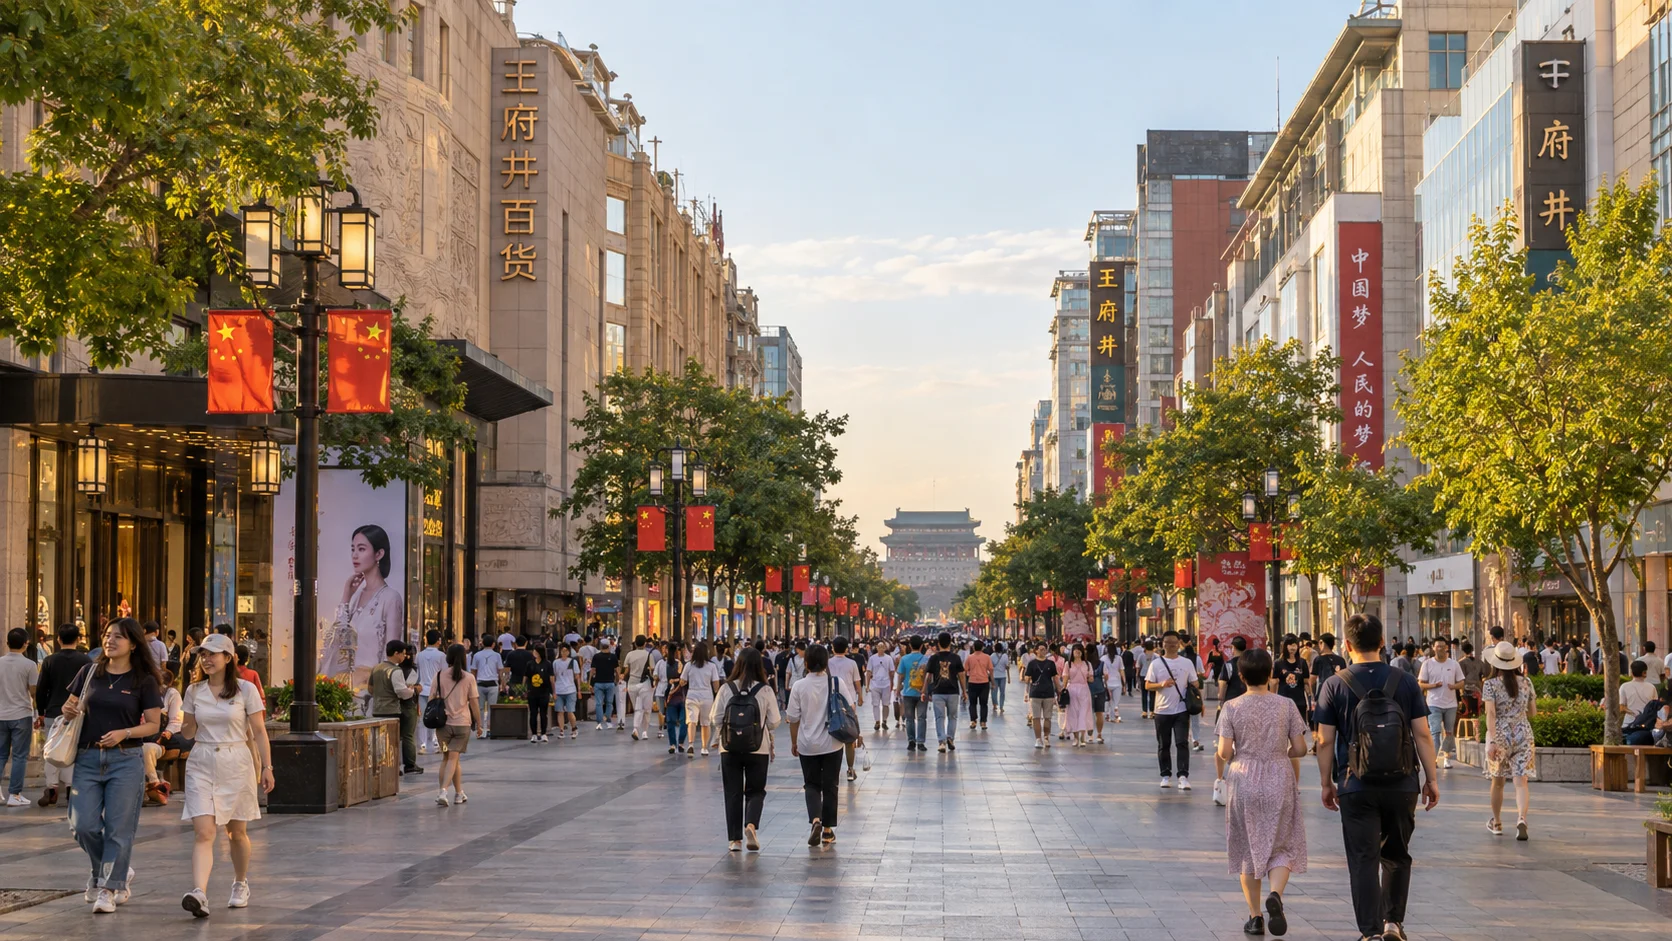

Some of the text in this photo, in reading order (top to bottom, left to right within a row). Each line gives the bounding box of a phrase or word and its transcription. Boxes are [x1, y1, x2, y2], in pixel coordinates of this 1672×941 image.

[500, 60, 538, 281] 王府井百货
[1096, 268, 1118, 357] 王府井
[1351, 248, 1371, 329] 中国梦
[1353, 351, 1373, 448] 人民的梦
